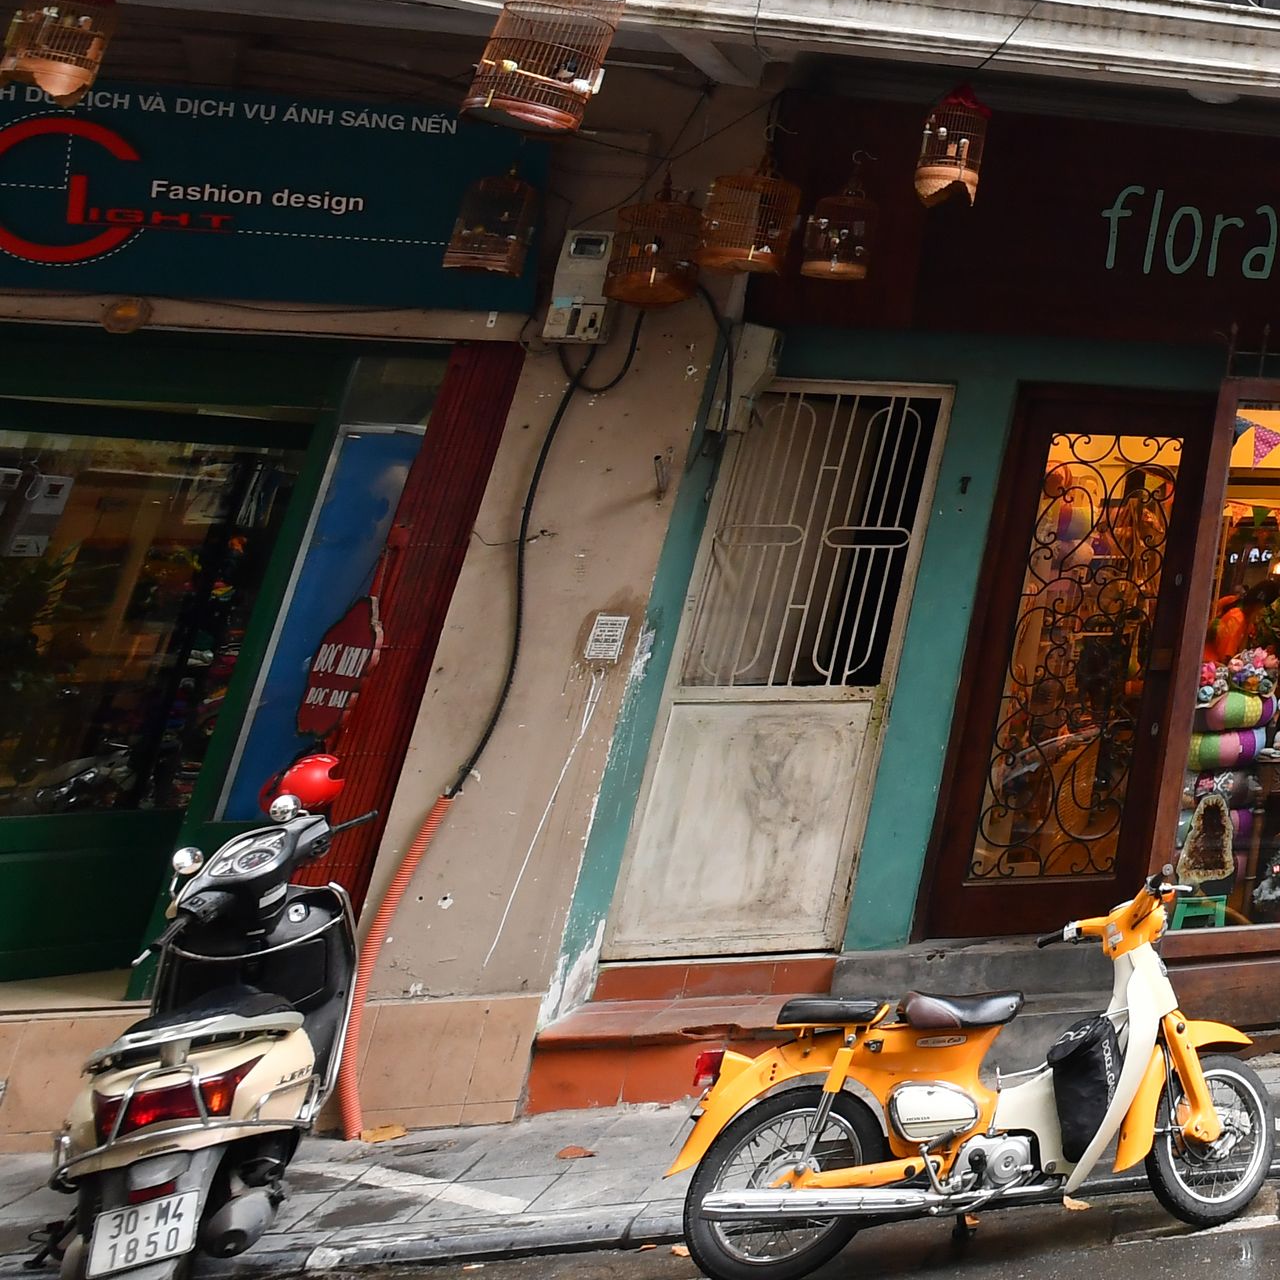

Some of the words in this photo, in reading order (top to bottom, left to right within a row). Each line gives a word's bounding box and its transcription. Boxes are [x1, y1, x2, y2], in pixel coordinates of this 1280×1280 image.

[138, 92, 167, 113] VÀ
[175, 98, 235, 120] DỊCH
[244, 103, 277, 124] VỤ
[282, 101, 335, 126] ÁNH
[340, 108, 405, 131] SÁNG
[411, 112, 458, 135] NẾN
[150, 180, 262, 205] Fashion
[271, 188, 365, 214] design
[1101, 185, 1278, 280] flora
[109, 1196, 185, 1240] 30-M4
[108, 1226, 180, 1270] 1850
